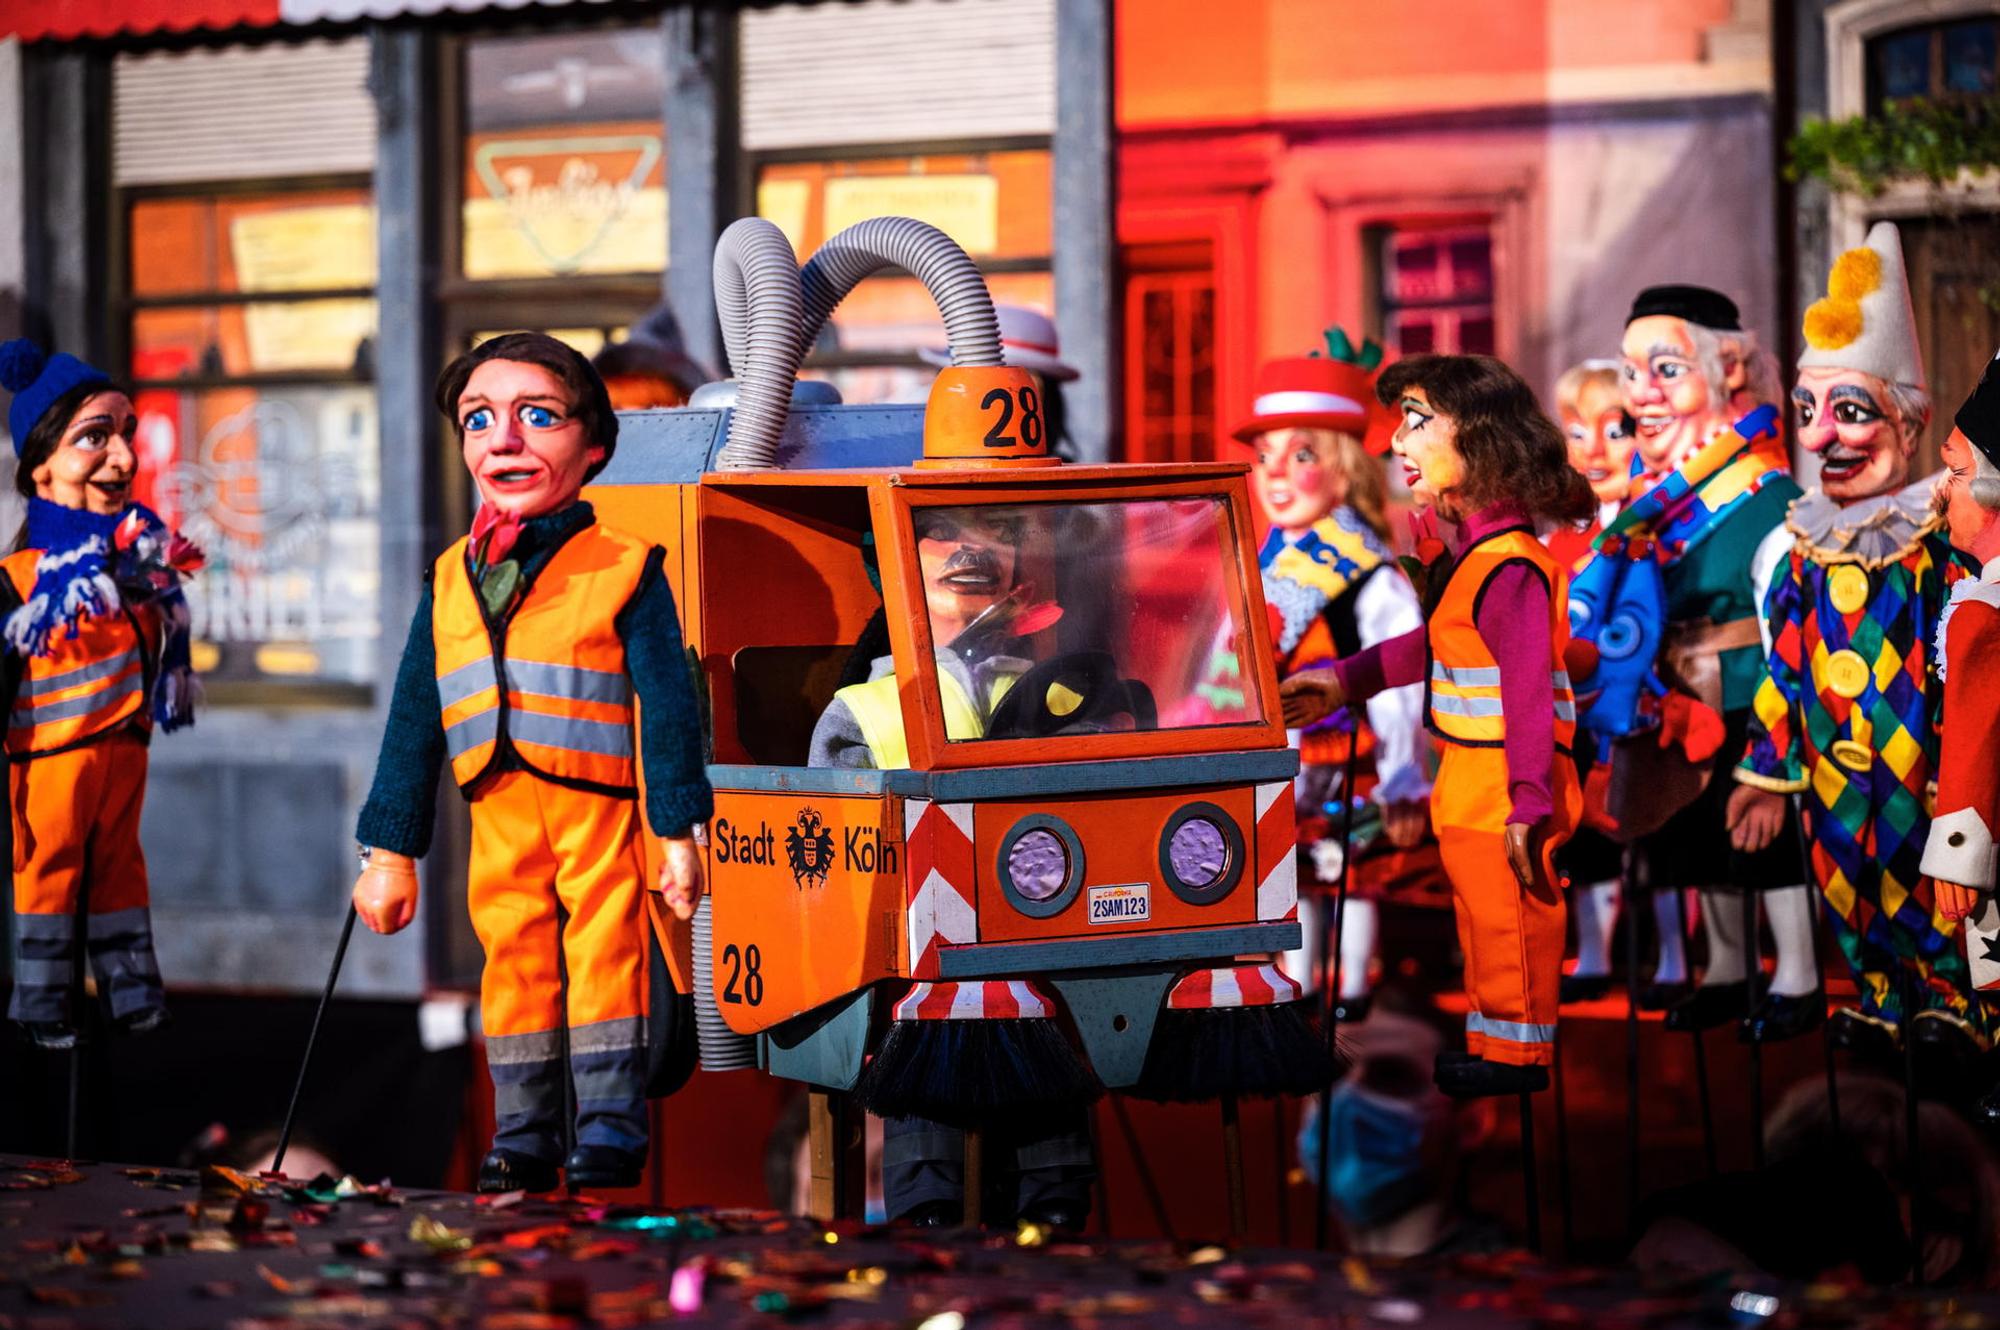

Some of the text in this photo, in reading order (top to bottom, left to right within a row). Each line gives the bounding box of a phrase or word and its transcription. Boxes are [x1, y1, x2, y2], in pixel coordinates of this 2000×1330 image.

[981, 386, 1041, 447] 28
[715, 818, 897, 874] Stadt Köln
[1093, 896, 1146, 918] 2SAM123
[722, 943, 764, 1007] 28
